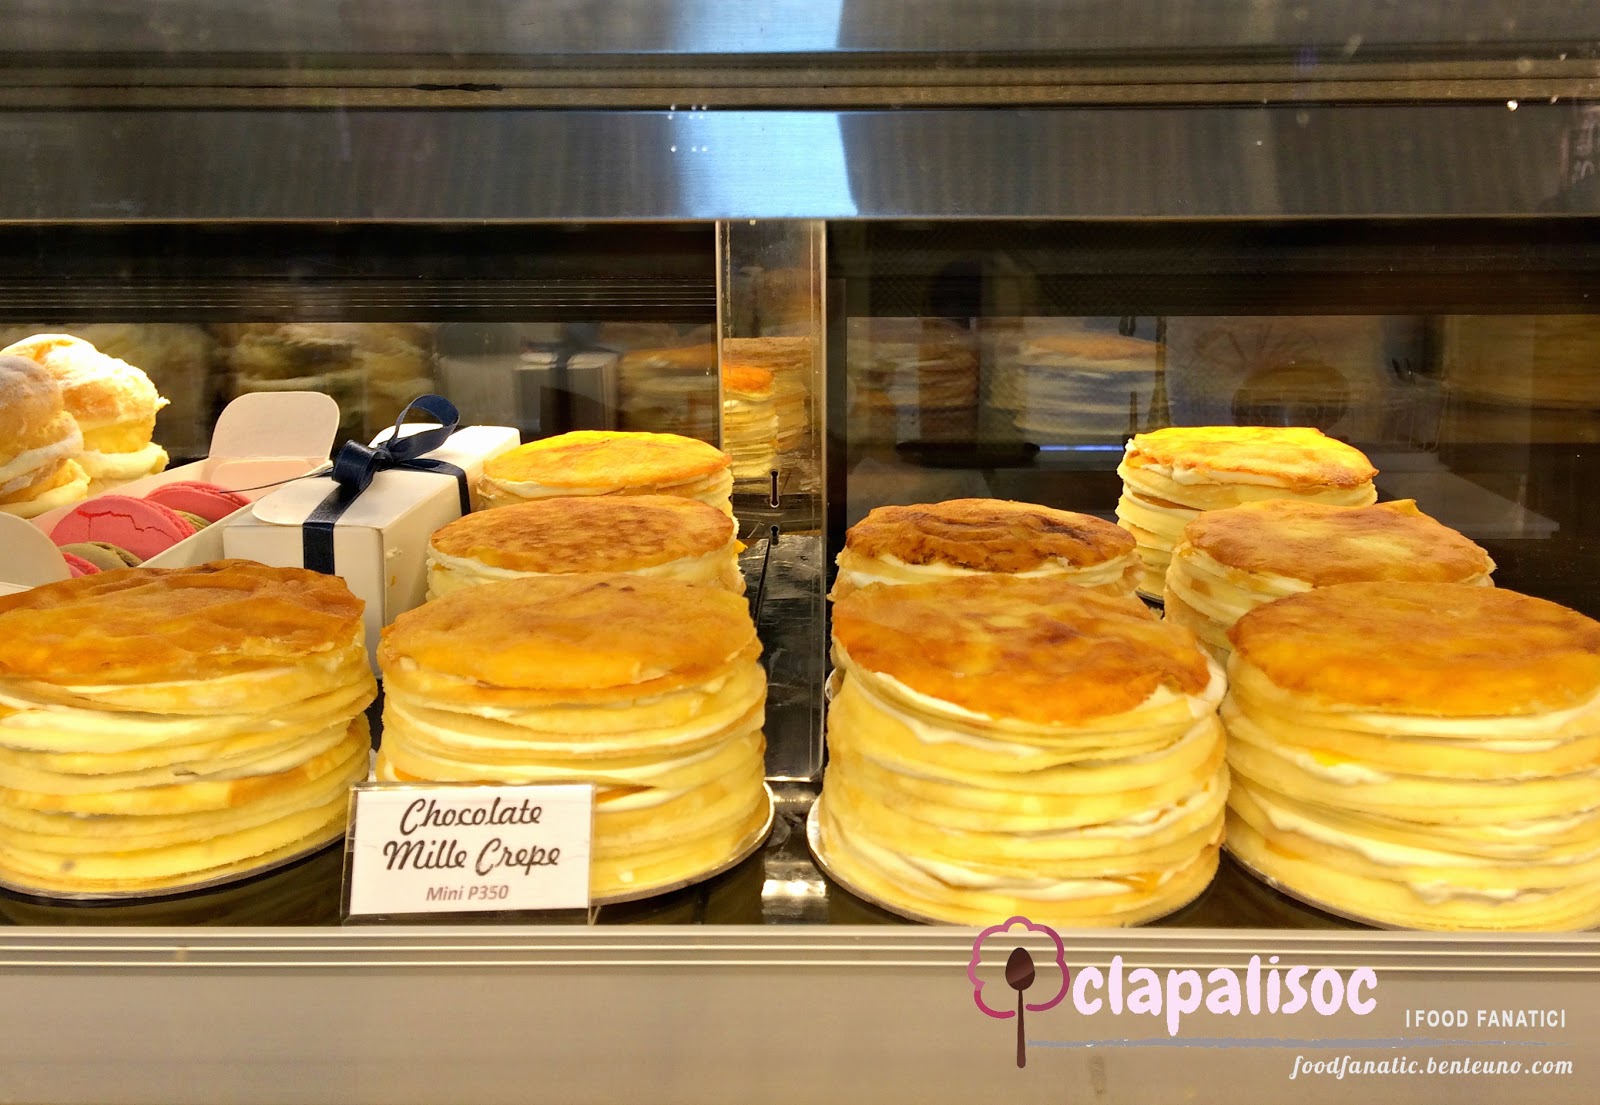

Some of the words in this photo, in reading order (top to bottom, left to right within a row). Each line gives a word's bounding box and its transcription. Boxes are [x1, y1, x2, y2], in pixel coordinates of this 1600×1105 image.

[400, 797, 542, 836] Chocolate
[383, 839, 467, 870] Mille
[475, 838, 560, 876] Crepe
[426, 887, 464, 901] Mini
[467, 885, 509, 900] P350
